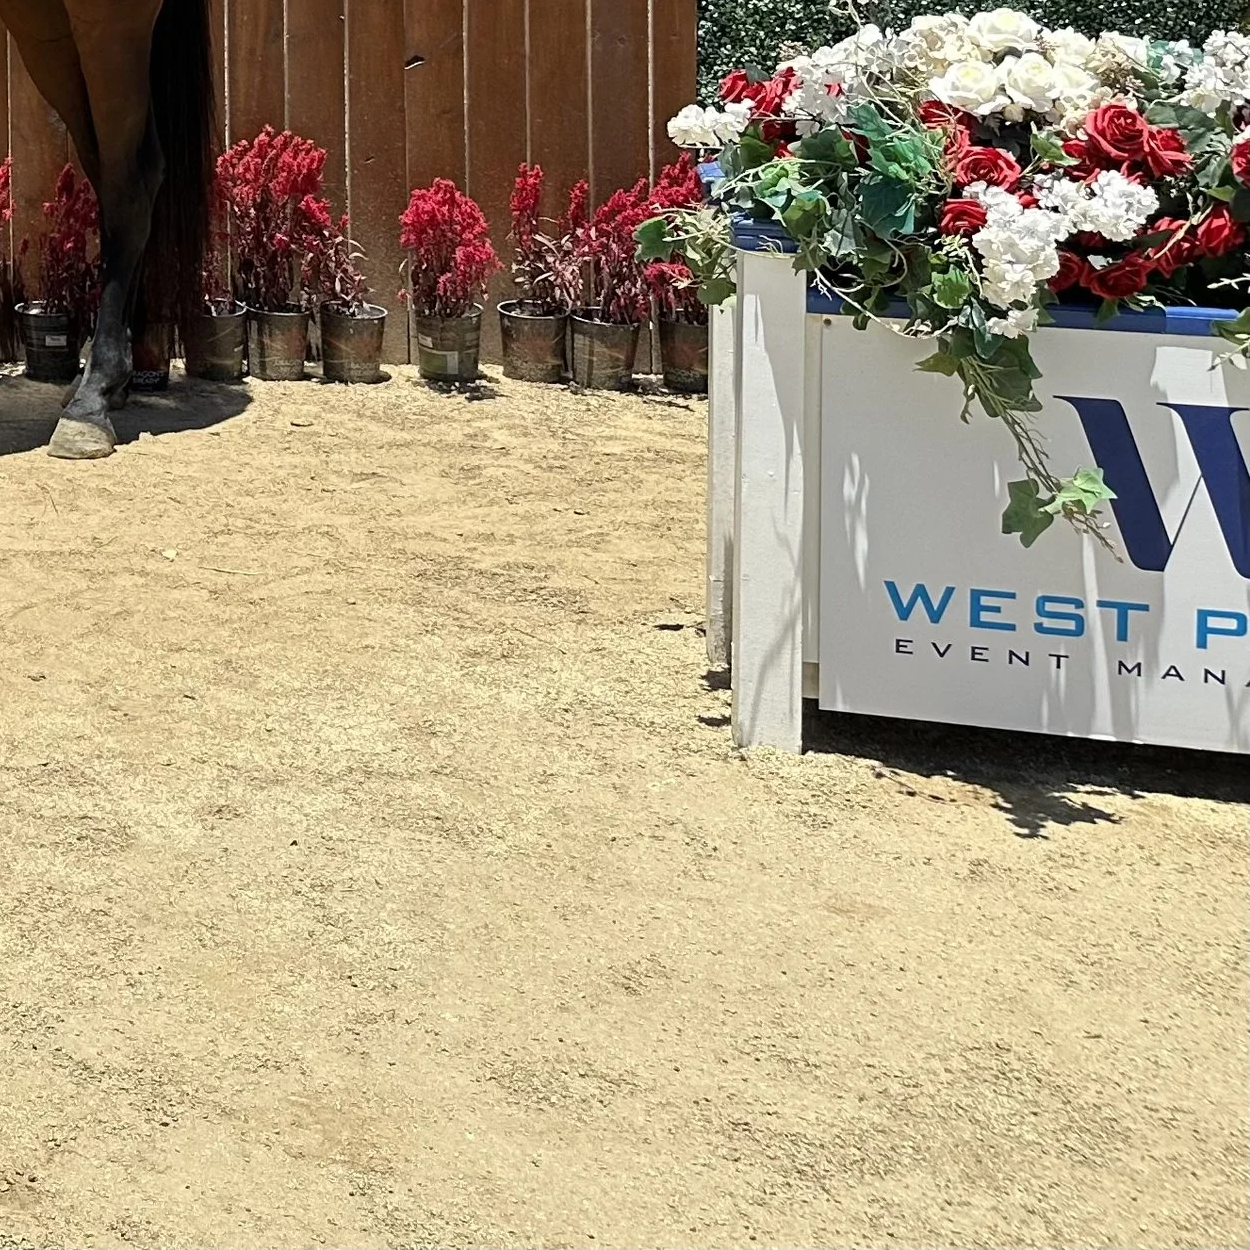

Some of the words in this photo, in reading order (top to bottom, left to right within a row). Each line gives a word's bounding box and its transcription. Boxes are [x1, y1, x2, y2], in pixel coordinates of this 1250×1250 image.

[884, 580, 1150, 642] WEST
[1196, 608, 1248, 650] P
[895, 638, 1070, 670] EVENT
[1117, 660, 1250, 687] MAN
